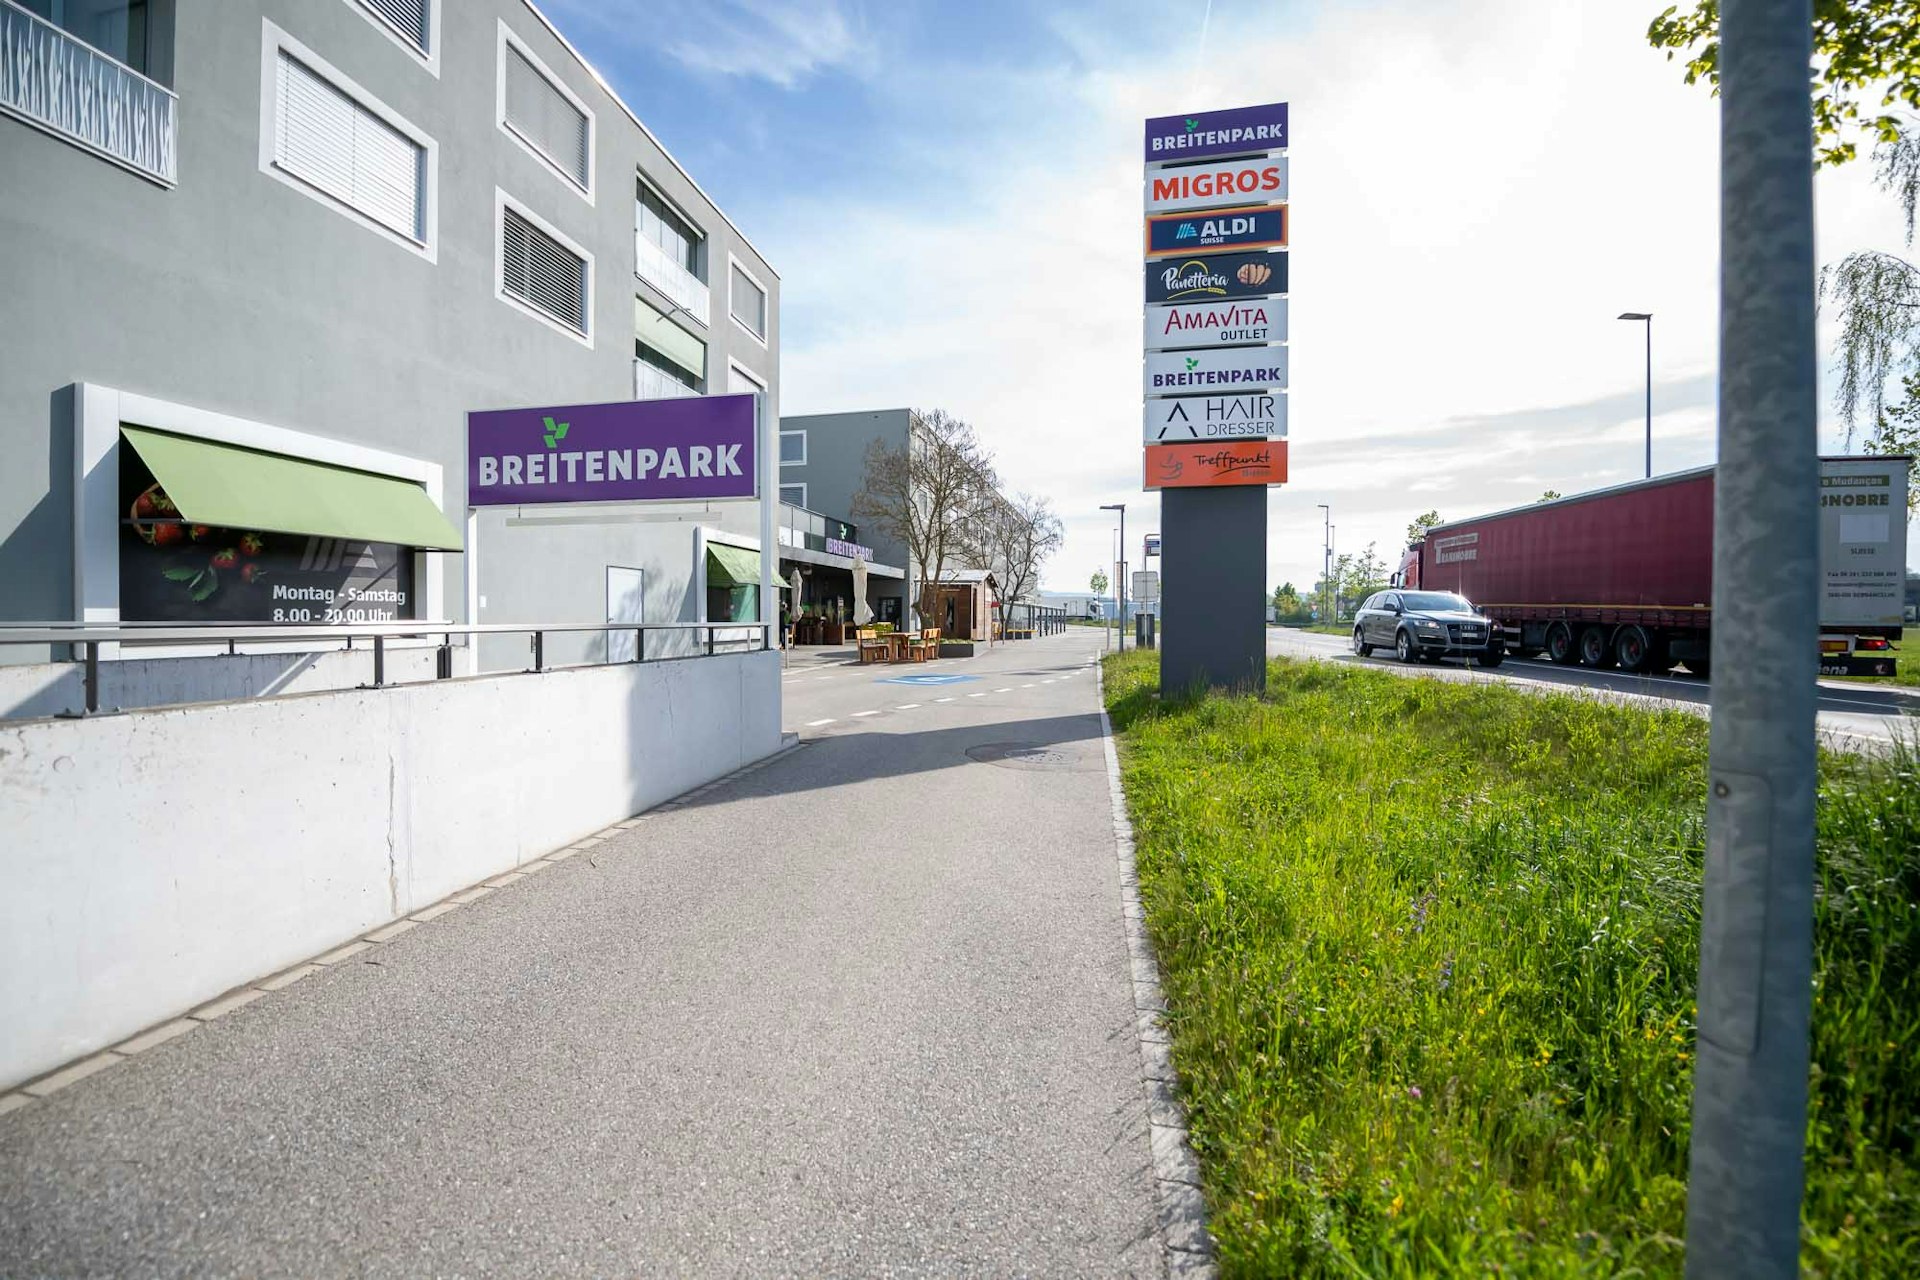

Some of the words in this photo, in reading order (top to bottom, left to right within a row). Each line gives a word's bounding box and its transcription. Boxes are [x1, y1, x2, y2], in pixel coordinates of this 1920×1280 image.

[1152, 124, 1283, 151] BREITENPARK
[1153, 167, 1281, 201] MIGROS
[1200, 217, 1256, 238] ALDI
[1200, 236, 1225, 245] SUISSE
[1161, 267, 1230, 290] Panetteria
[1220, 328, 1268, 341] OUTLET
[1153, 367, 1281, 387] BREITENPARK
[1206, 396, 1275, 421] HAIR
[1206, 421, 1275, 436] DRESSER
[478, 444, 744, 487] BREITENPARK
[1193, 450, 1271, 469] Treffpunkt
[273, 585, 335, 603] Montag
[348, 587, 406, 605] Samstag
[273, 608, 311, 622] 8.00
[324, 608, 365, 623] 20.00
[369, 608, 393, 622] Uhr
